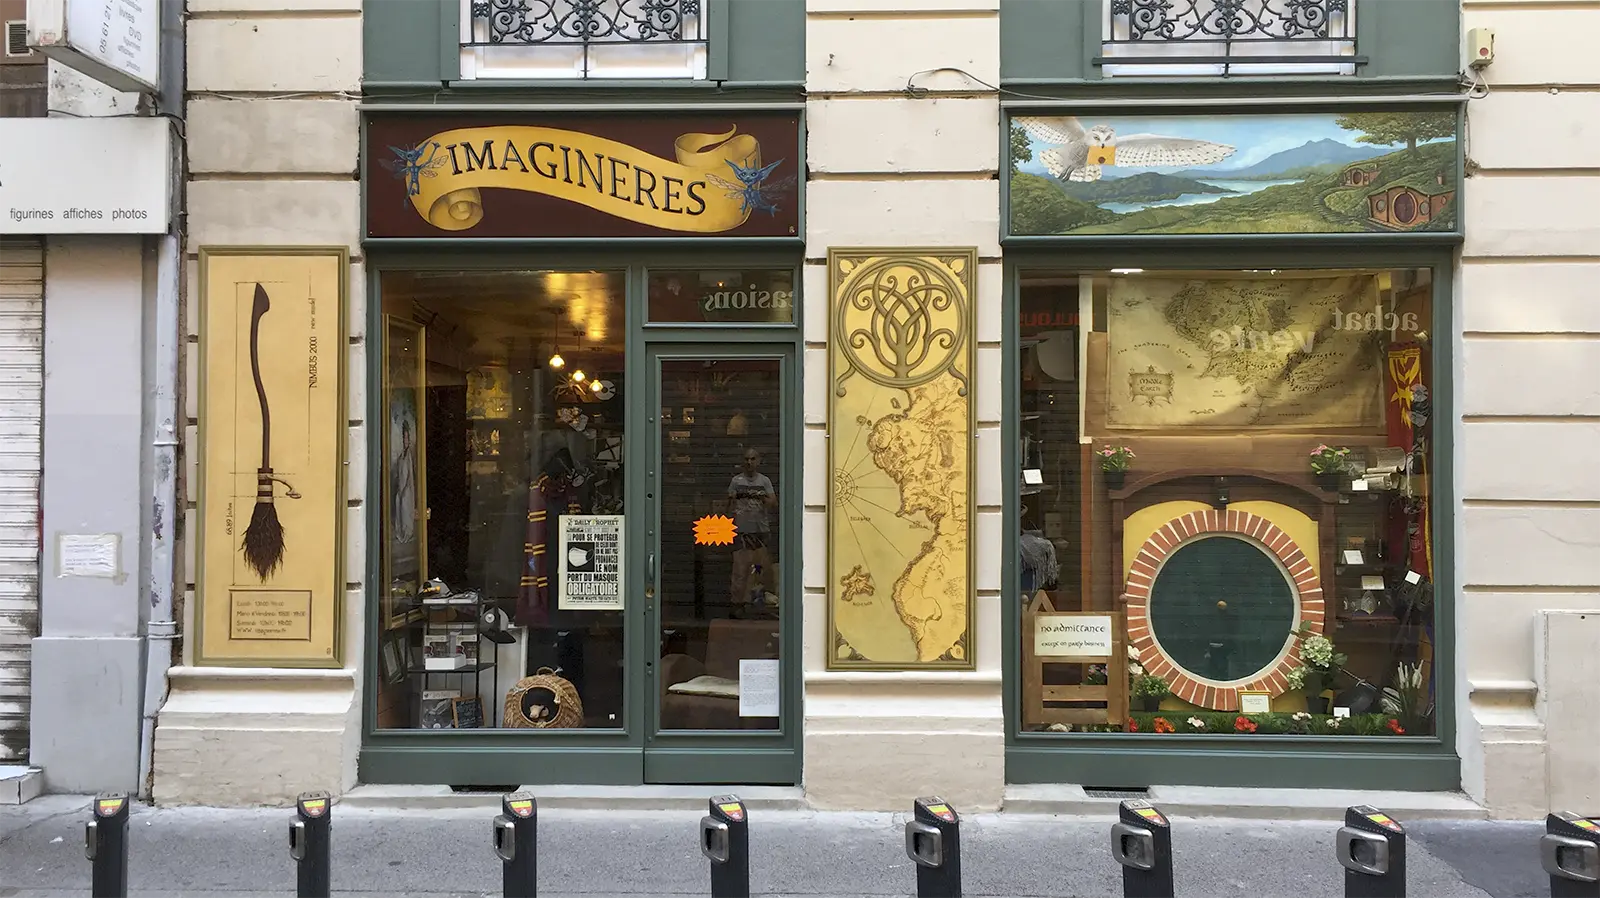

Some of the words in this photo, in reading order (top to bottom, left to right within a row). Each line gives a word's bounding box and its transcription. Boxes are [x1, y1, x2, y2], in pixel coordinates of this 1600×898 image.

[445, 139, 707, 216] IMAGINERES
[10, 208, 54, 222] figurines
[63, 208, 103, 219] affiches
[112, 208, 148, 221] photos
[309, 336, 318, 354] 2000
[308, 355, 318, 388] NIMBUS
[573, 533, 585, 541] POUR
[586, 533, 593, 541] SE
[595, 564, 602, 572] LE
[603, 564, 618, 572] NOM
[567, 573, 583, 581] PORT
[584, 573, 592, 581] DU
[593, 573, 618, 583] MASQUE
[567, 582, 618, 595] OBLIGATOIRE
[1053, 623, 1106, 633] admittance
